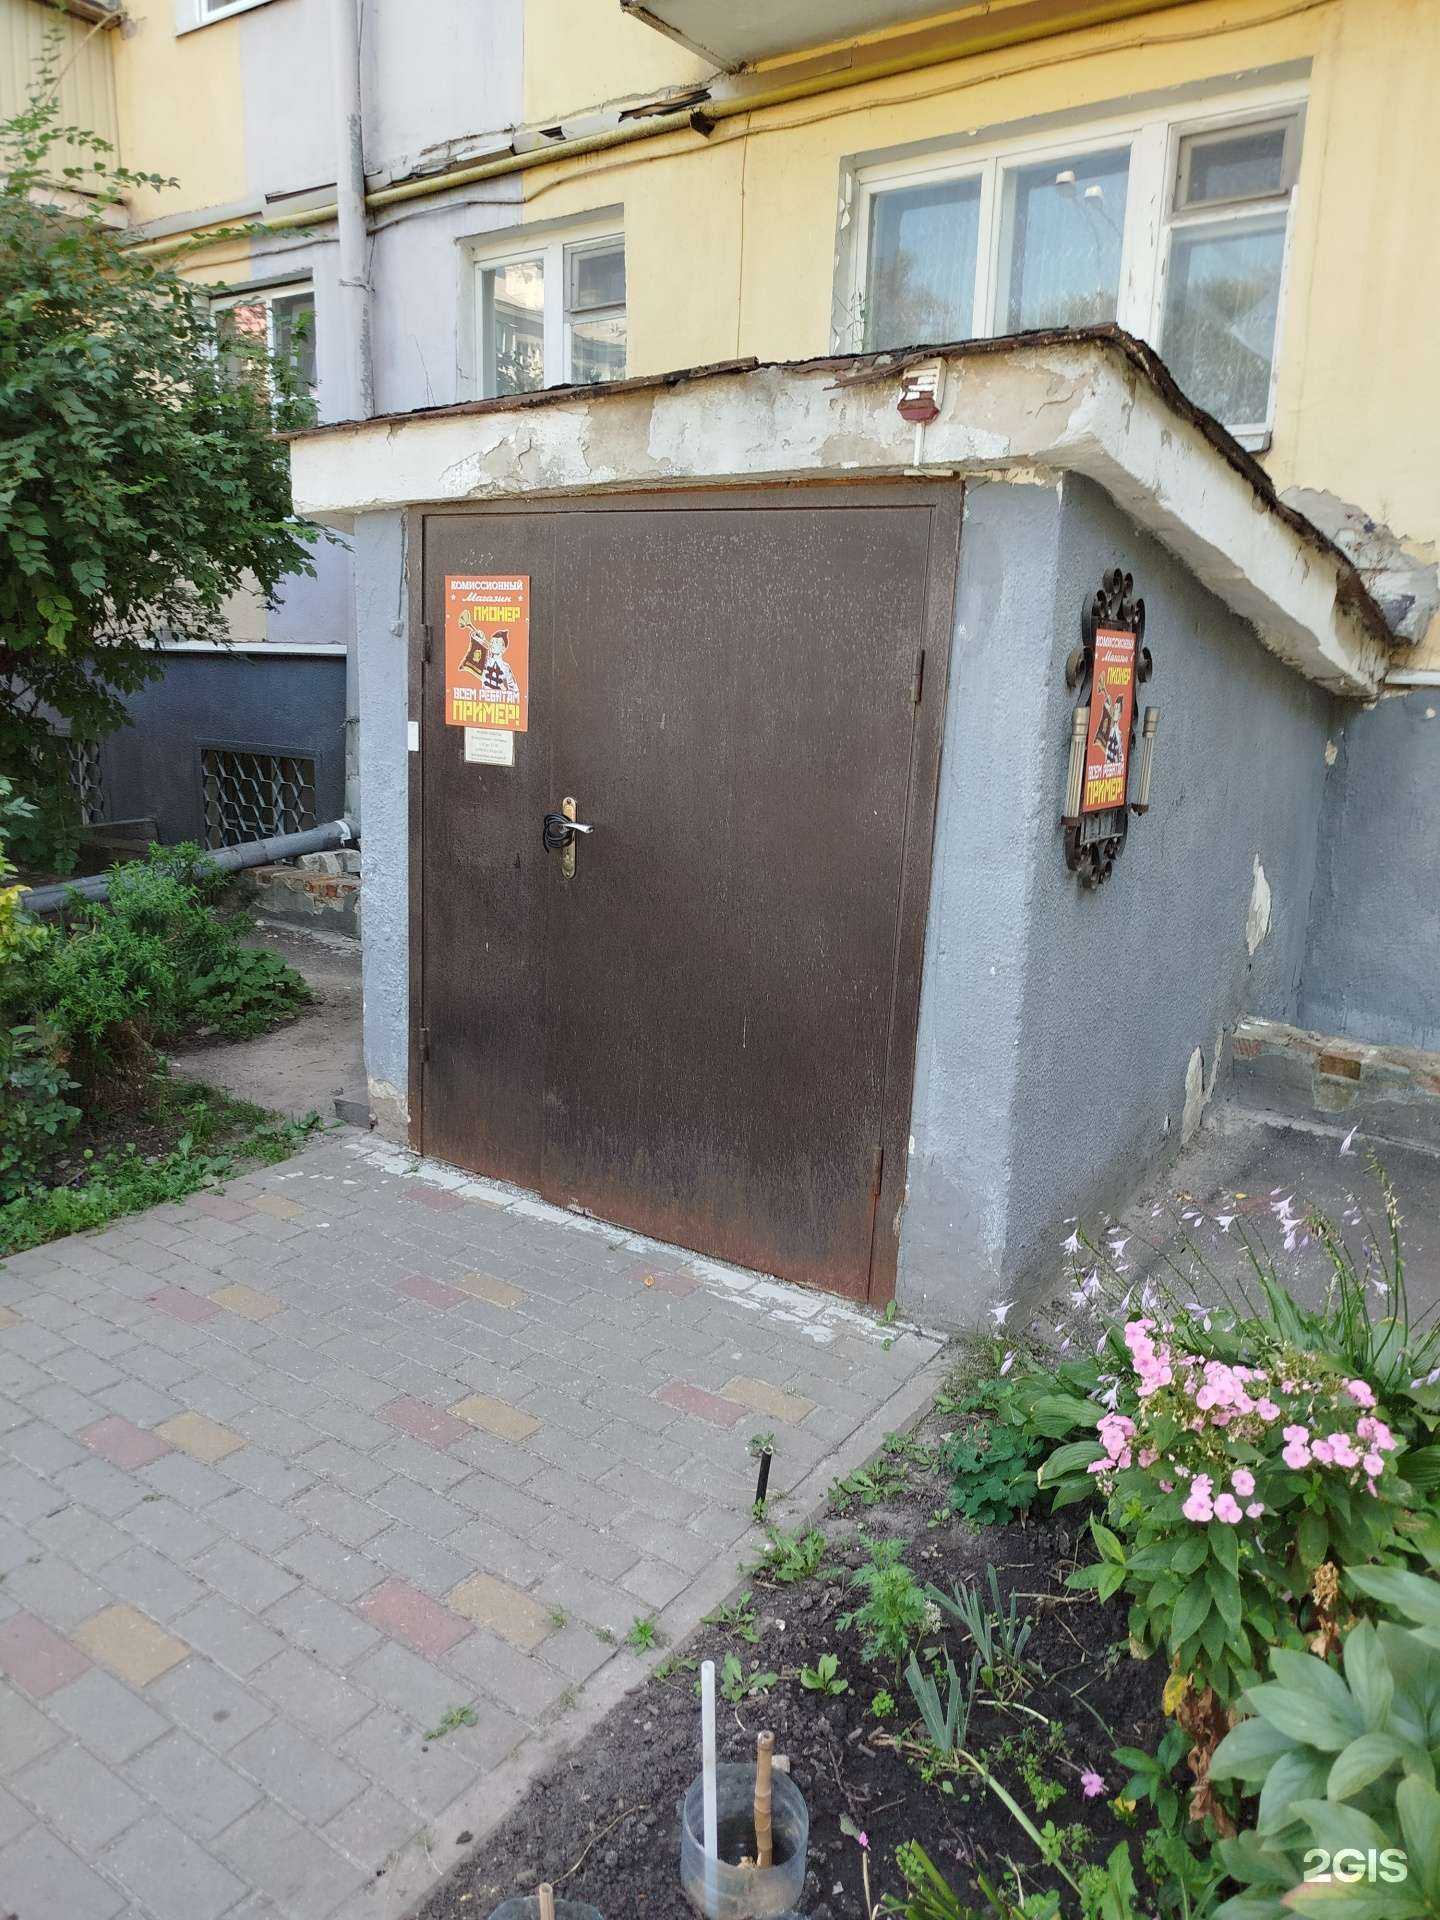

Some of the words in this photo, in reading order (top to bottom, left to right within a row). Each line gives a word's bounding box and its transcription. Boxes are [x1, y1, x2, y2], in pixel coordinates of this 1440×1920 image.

[451, 580, 523, 591] КОМИССИОННЫЙ
[461, 592, 512, 603] Магазин
[473, 606, 520, 623] ПИОНЕР
[1107, 667, 1131, 685] ПИОНЕР
[453, 687, 476, 700] ВСЕМ
[479, 689, 520, 703] РЕБЯТАМ
[452, 701, 520, 726] ПРИМЕР!
[1086, 777, 1123, 805] ПРИМЕР!
